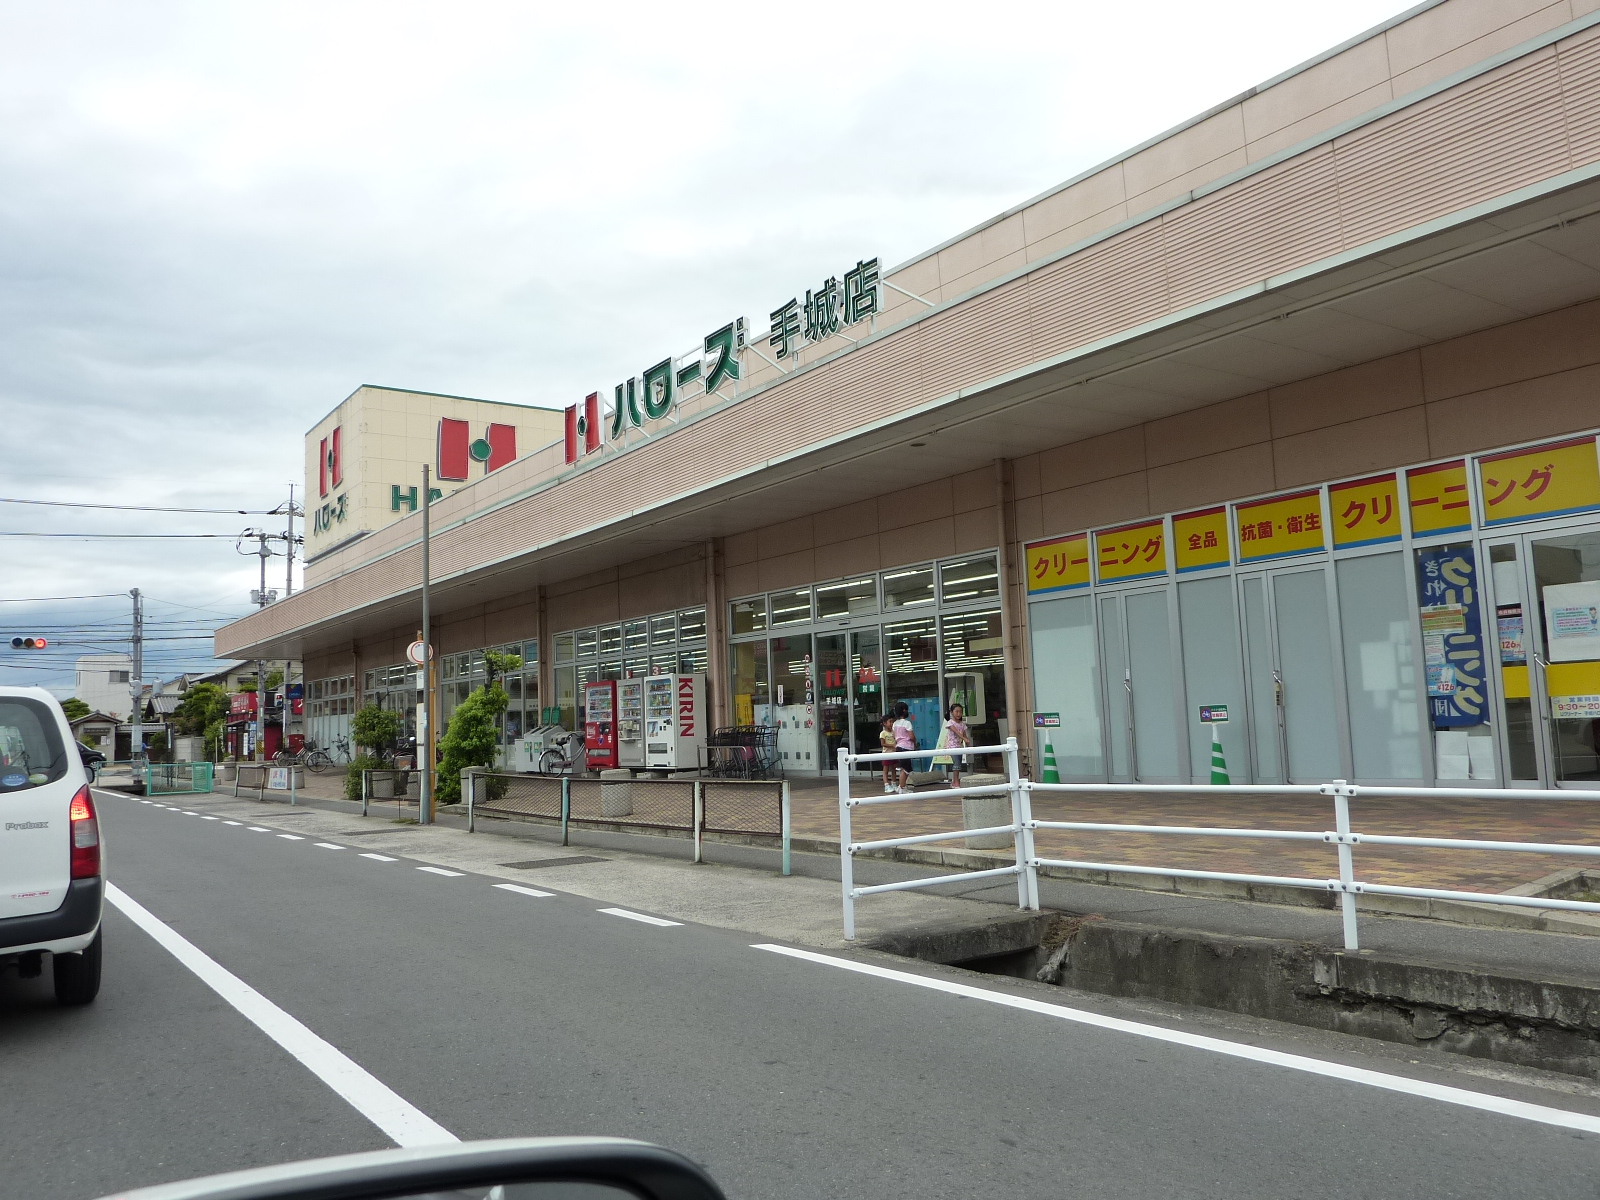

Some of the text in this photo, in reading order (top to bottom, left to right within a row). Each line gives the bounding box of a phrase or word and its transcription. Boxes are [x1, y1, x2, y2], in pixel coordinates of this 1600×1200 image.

[611, 257, 883, 440] ハローズ 手城店
[314, 492, 350, 537] ハローズ
[1341, 463, 1555, 529] クリーニング
[1187, 530, 1219, 551] 全品
[1241, 512, 1321, 542] 抗菌・衛生
[1033, 534, 1163, 581] クリーニング
[679, 677, 695, 738] KIRIN
[5, 820, 49, 831] Probox
